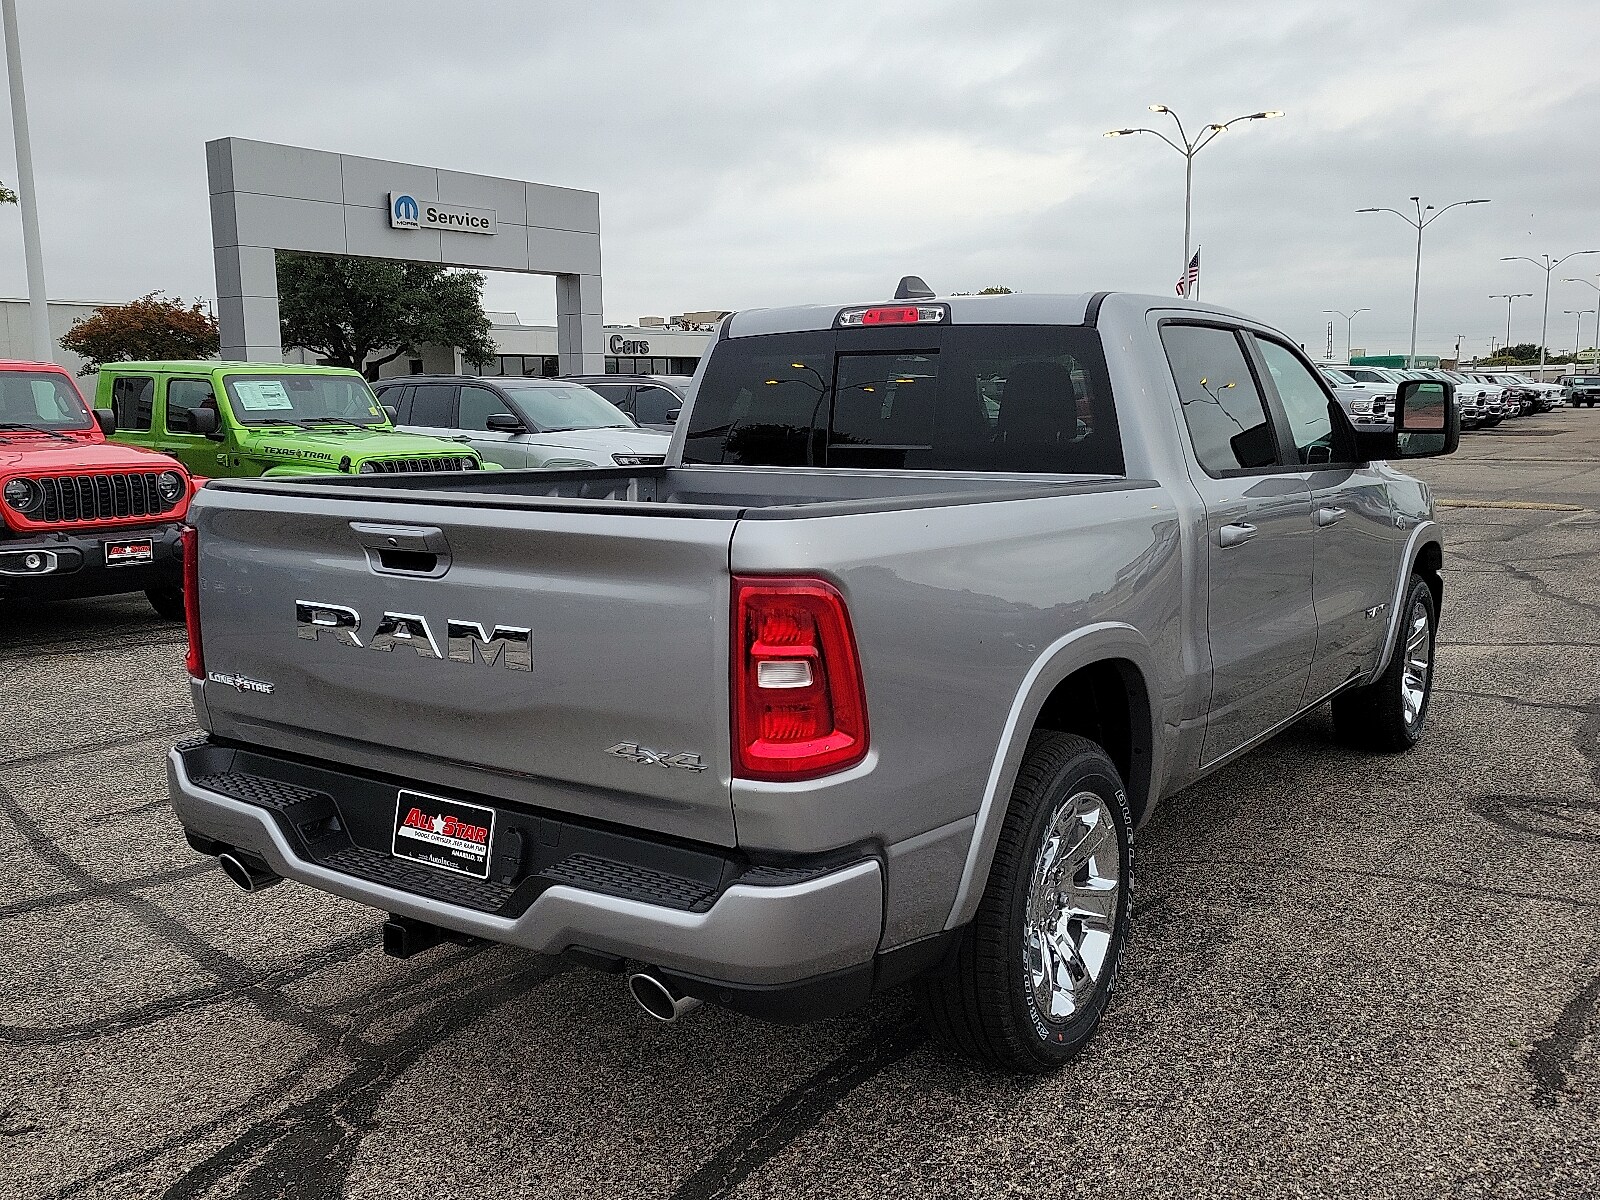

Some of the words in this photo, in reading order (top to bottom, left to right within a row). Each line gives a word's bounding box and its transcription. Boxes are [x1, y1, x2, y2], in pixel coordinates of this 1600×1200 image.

[426, 207, 490, 229] Service
[609, 334, 650, 354] Cars
[263, 446, 296, 456] TEXAS
[301, 450, 334, 461] TRAIL
[295, 599, 534, 672] RAM
[208, 671, 235, 686] LONE
[242, 680, 274, 695] STAR
[415, 830, 430, 840] DODGE
[464, 842, 475, 850] RAM
[442, 816, 487, 843] STAR
